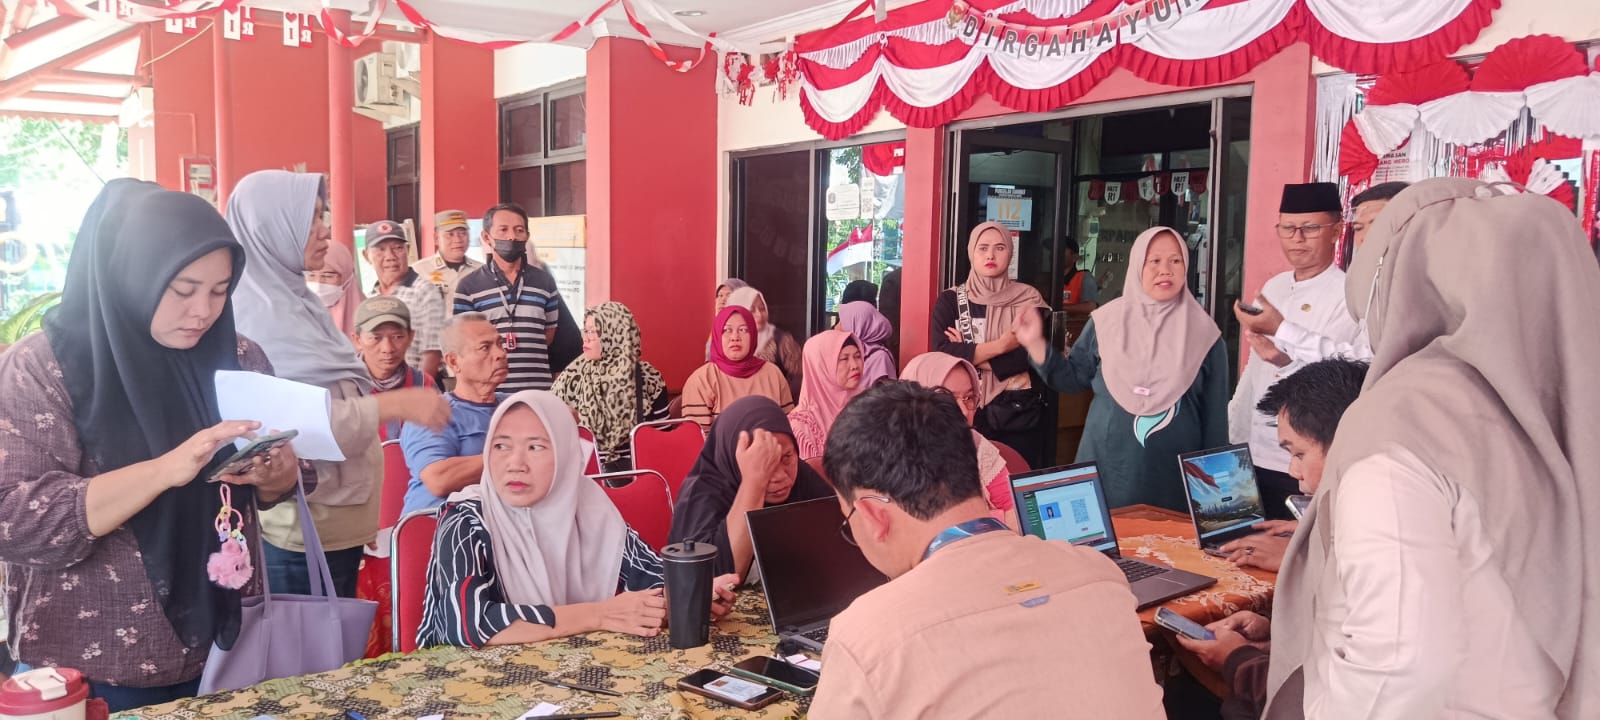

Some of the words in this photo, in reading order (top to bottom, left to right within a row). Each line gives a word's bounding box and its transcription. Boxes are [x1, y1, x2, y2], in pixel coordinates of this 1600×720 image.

[1174, 182, 1184, 193] RI
[1107, 192, 1116, 202] RI
[997, 201, 1023, 220] 112
